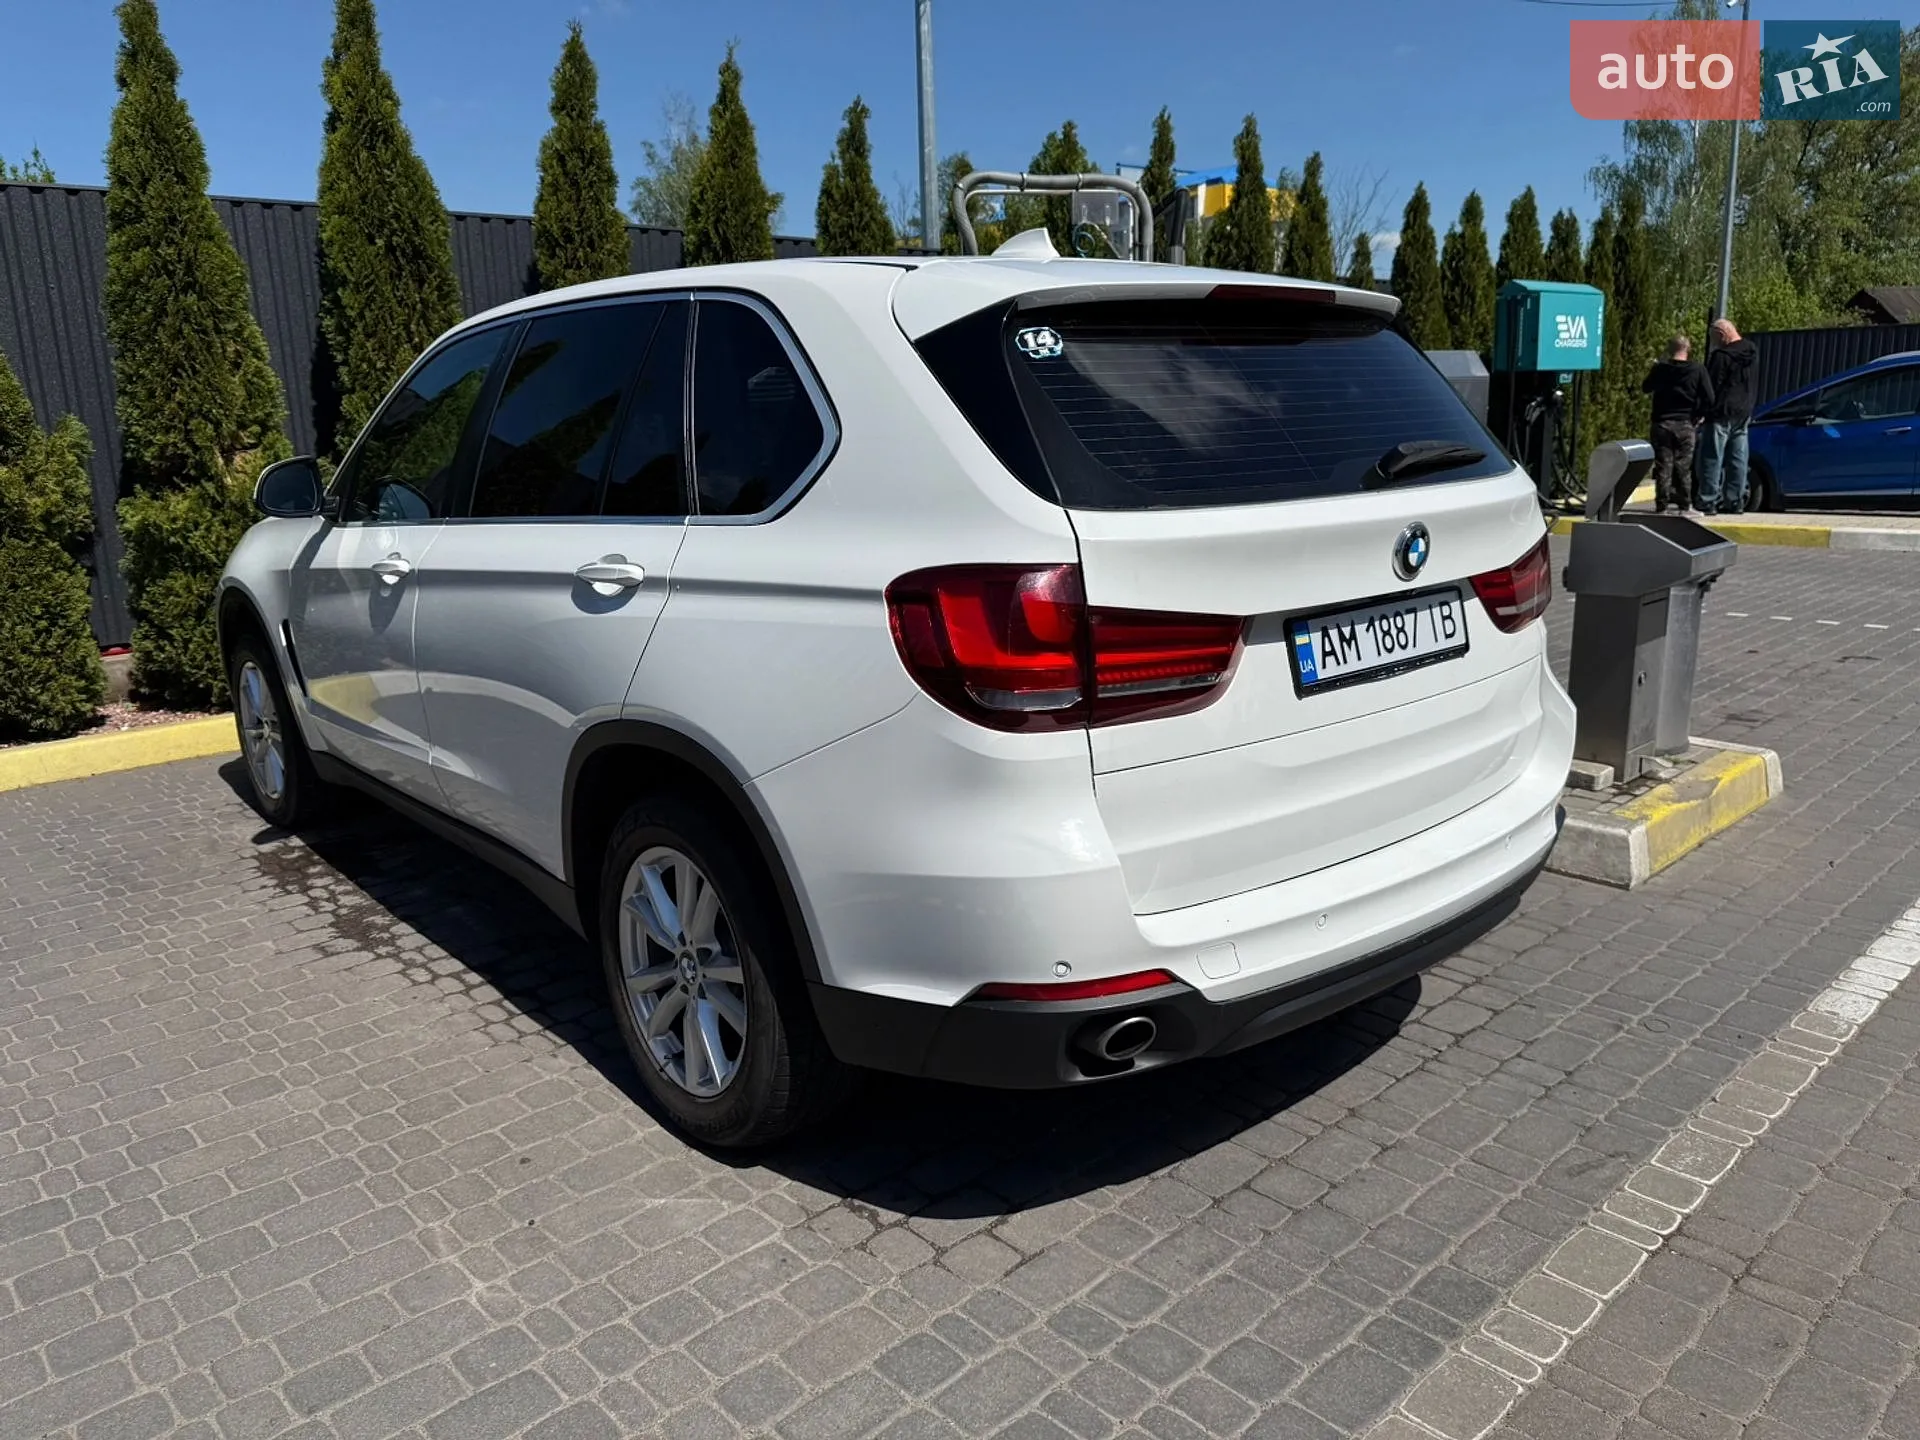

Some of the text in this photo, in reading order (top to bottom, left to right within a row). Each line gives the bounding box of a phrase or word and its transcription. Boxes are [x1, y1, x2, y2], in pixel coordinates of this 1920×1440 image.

[1555, 315, 1588, 339] EVA
[1321, 601, 1456, 669] AM 1887 IB
[1300, 660, 1315, 673] UA
